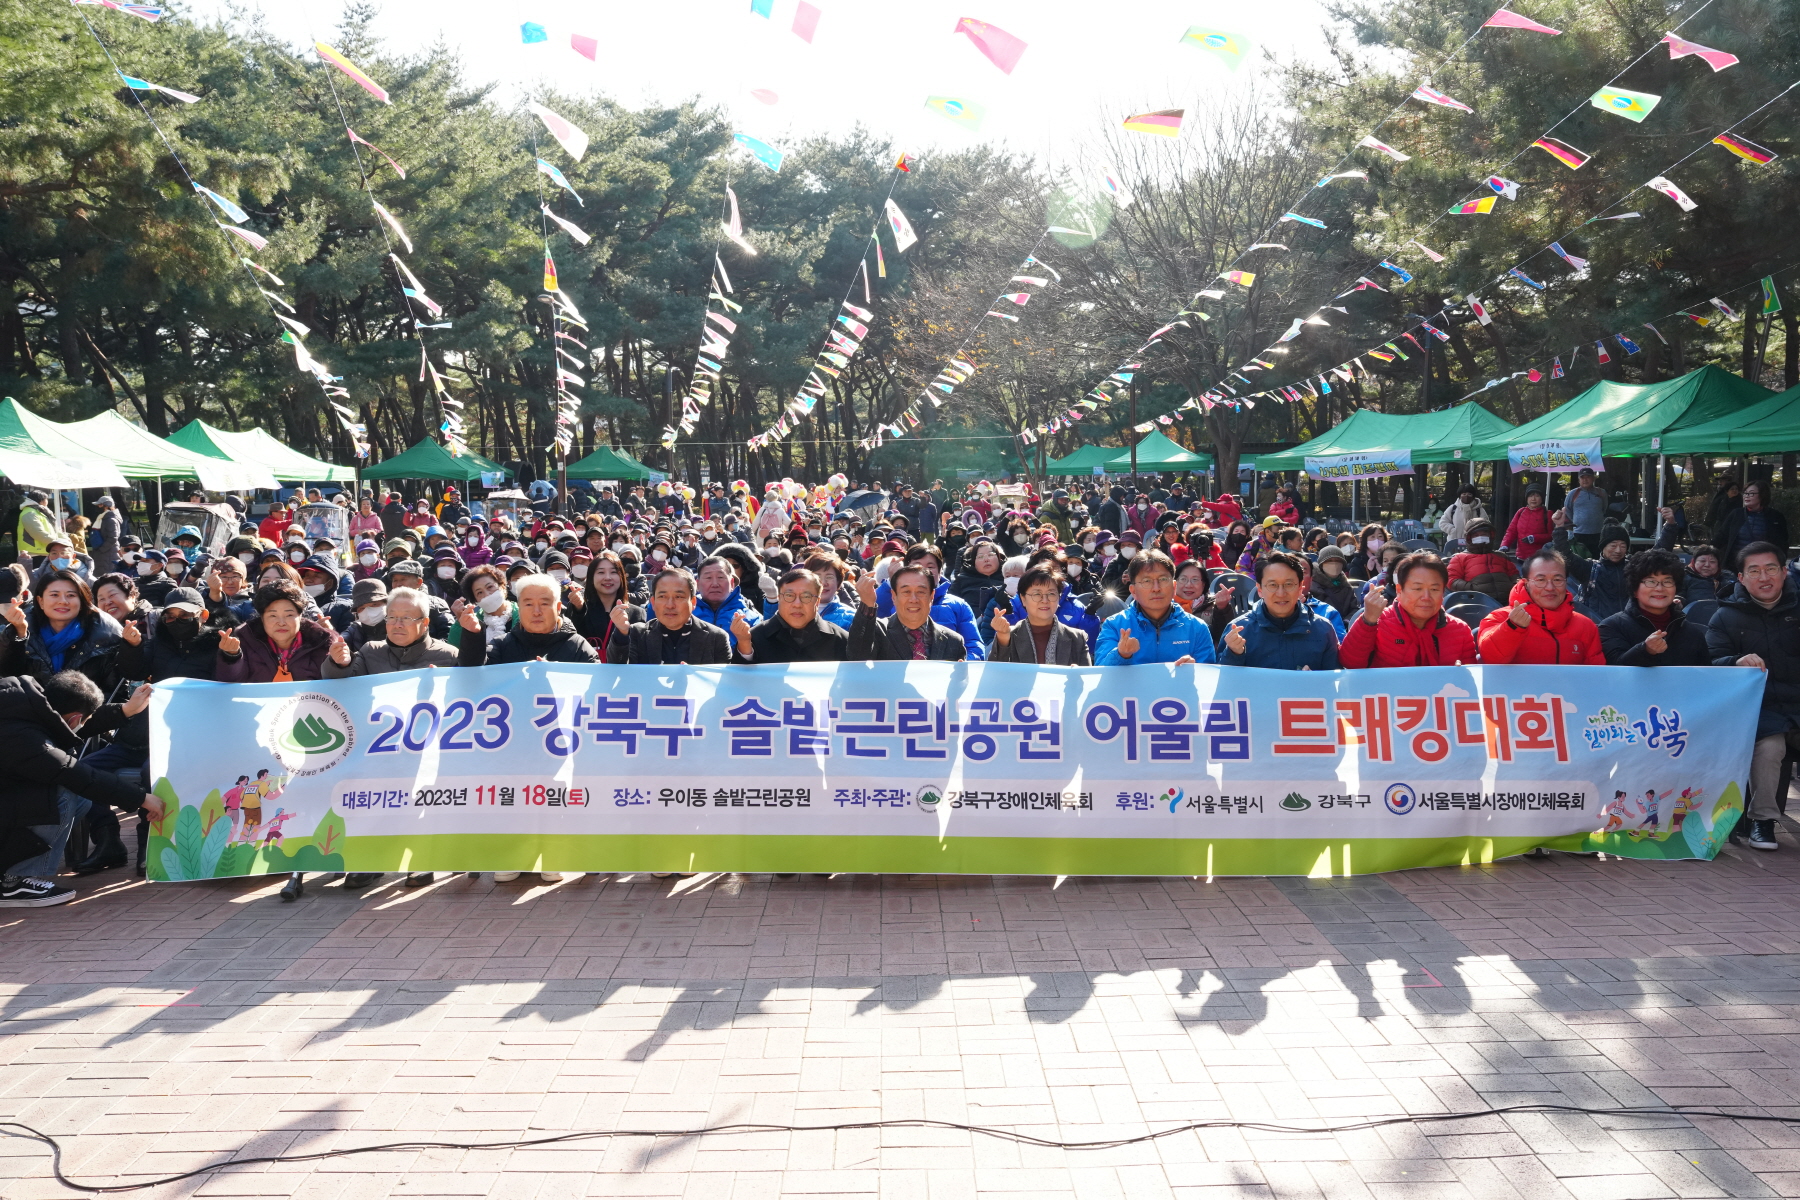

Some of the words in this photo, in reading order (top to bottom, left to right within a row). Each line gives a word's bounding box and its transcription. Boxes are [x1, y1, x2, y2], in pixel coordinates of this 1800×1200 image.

[330, 701, 341, 711] for
[340, 711, 350, 724] the
[367, 696, 511, 755] 2023
[534, 695, 703, 757] 강북구
[722, 698, 1061, 761] 솔밭근린공원
[1085, 698, 1250, 761] 어울림
[1273, 696, 1569, 762] 트래킹대회
[1633, 707, 1688, 758] 강북
[342, 725, 355, 757] Disabled
[342, 790, 409, 809] 대회기간:
[414, 788, 468, 807] 2023년
[475, 785, 515, 806] 11월
[521, 784, 590, 807] 18일(토)
[613, 788, 651, 807] 장소:
[657, 788, 708, 807] 우이동
[712, 788, 811, 807] 솔밭근린공원
[947, 790, 1093, 811] 강북구장애인체육회
[1115, 791, 1155, 811] 후원:
[1186, 795, 1264, 814] 서울특별시
[1317, 794, 1372, 809] 강북구
[1418, 792, 1586, 811] 서울특별시장애인체육회
